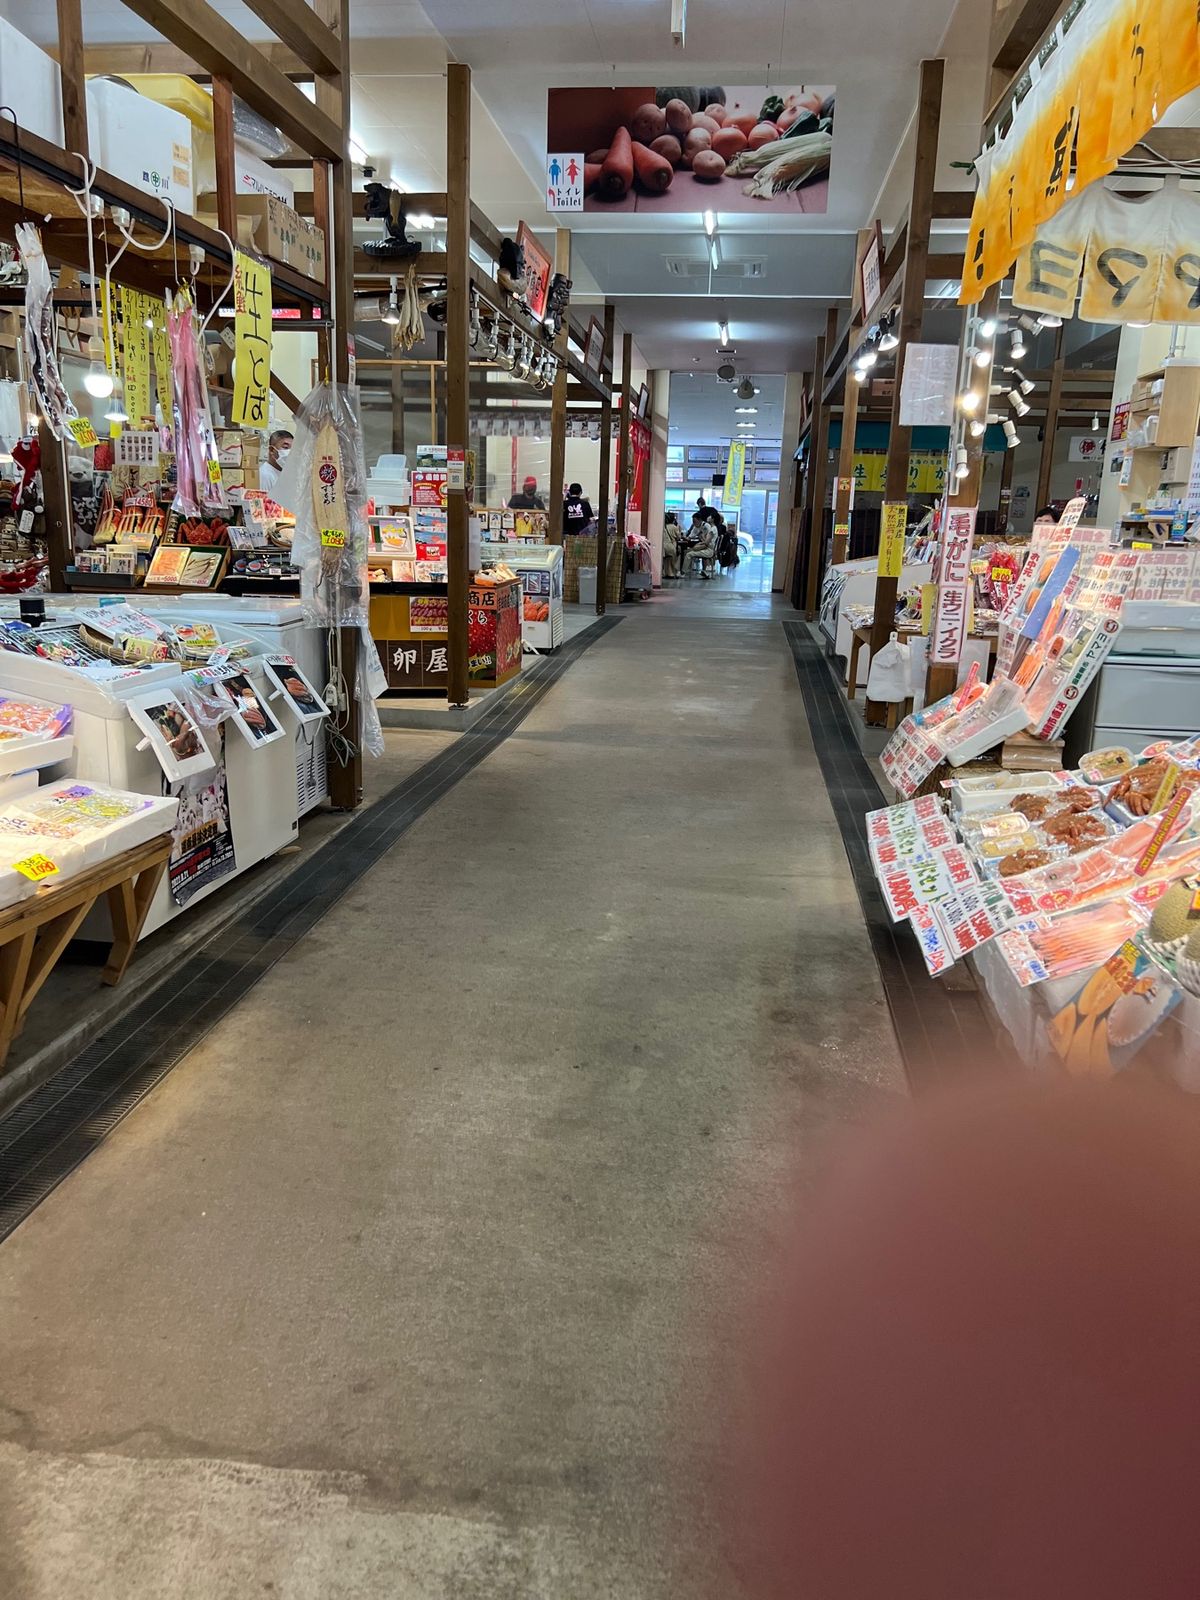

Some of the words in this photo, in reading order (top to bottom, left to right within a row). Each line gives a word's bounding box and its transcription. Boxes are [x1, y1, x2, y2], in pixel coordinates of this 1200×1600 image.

[557, 197, 581, 206] Toilet
[945, 512, 971, 582] 毛がに
[467, 591, 495, 606] 商店
[938, 590, 963, 659] 生ウニ・イクラ
[1086, 632, 1108, 659] ヤマヨ
[393, 647, 448, 674] 卵屋
